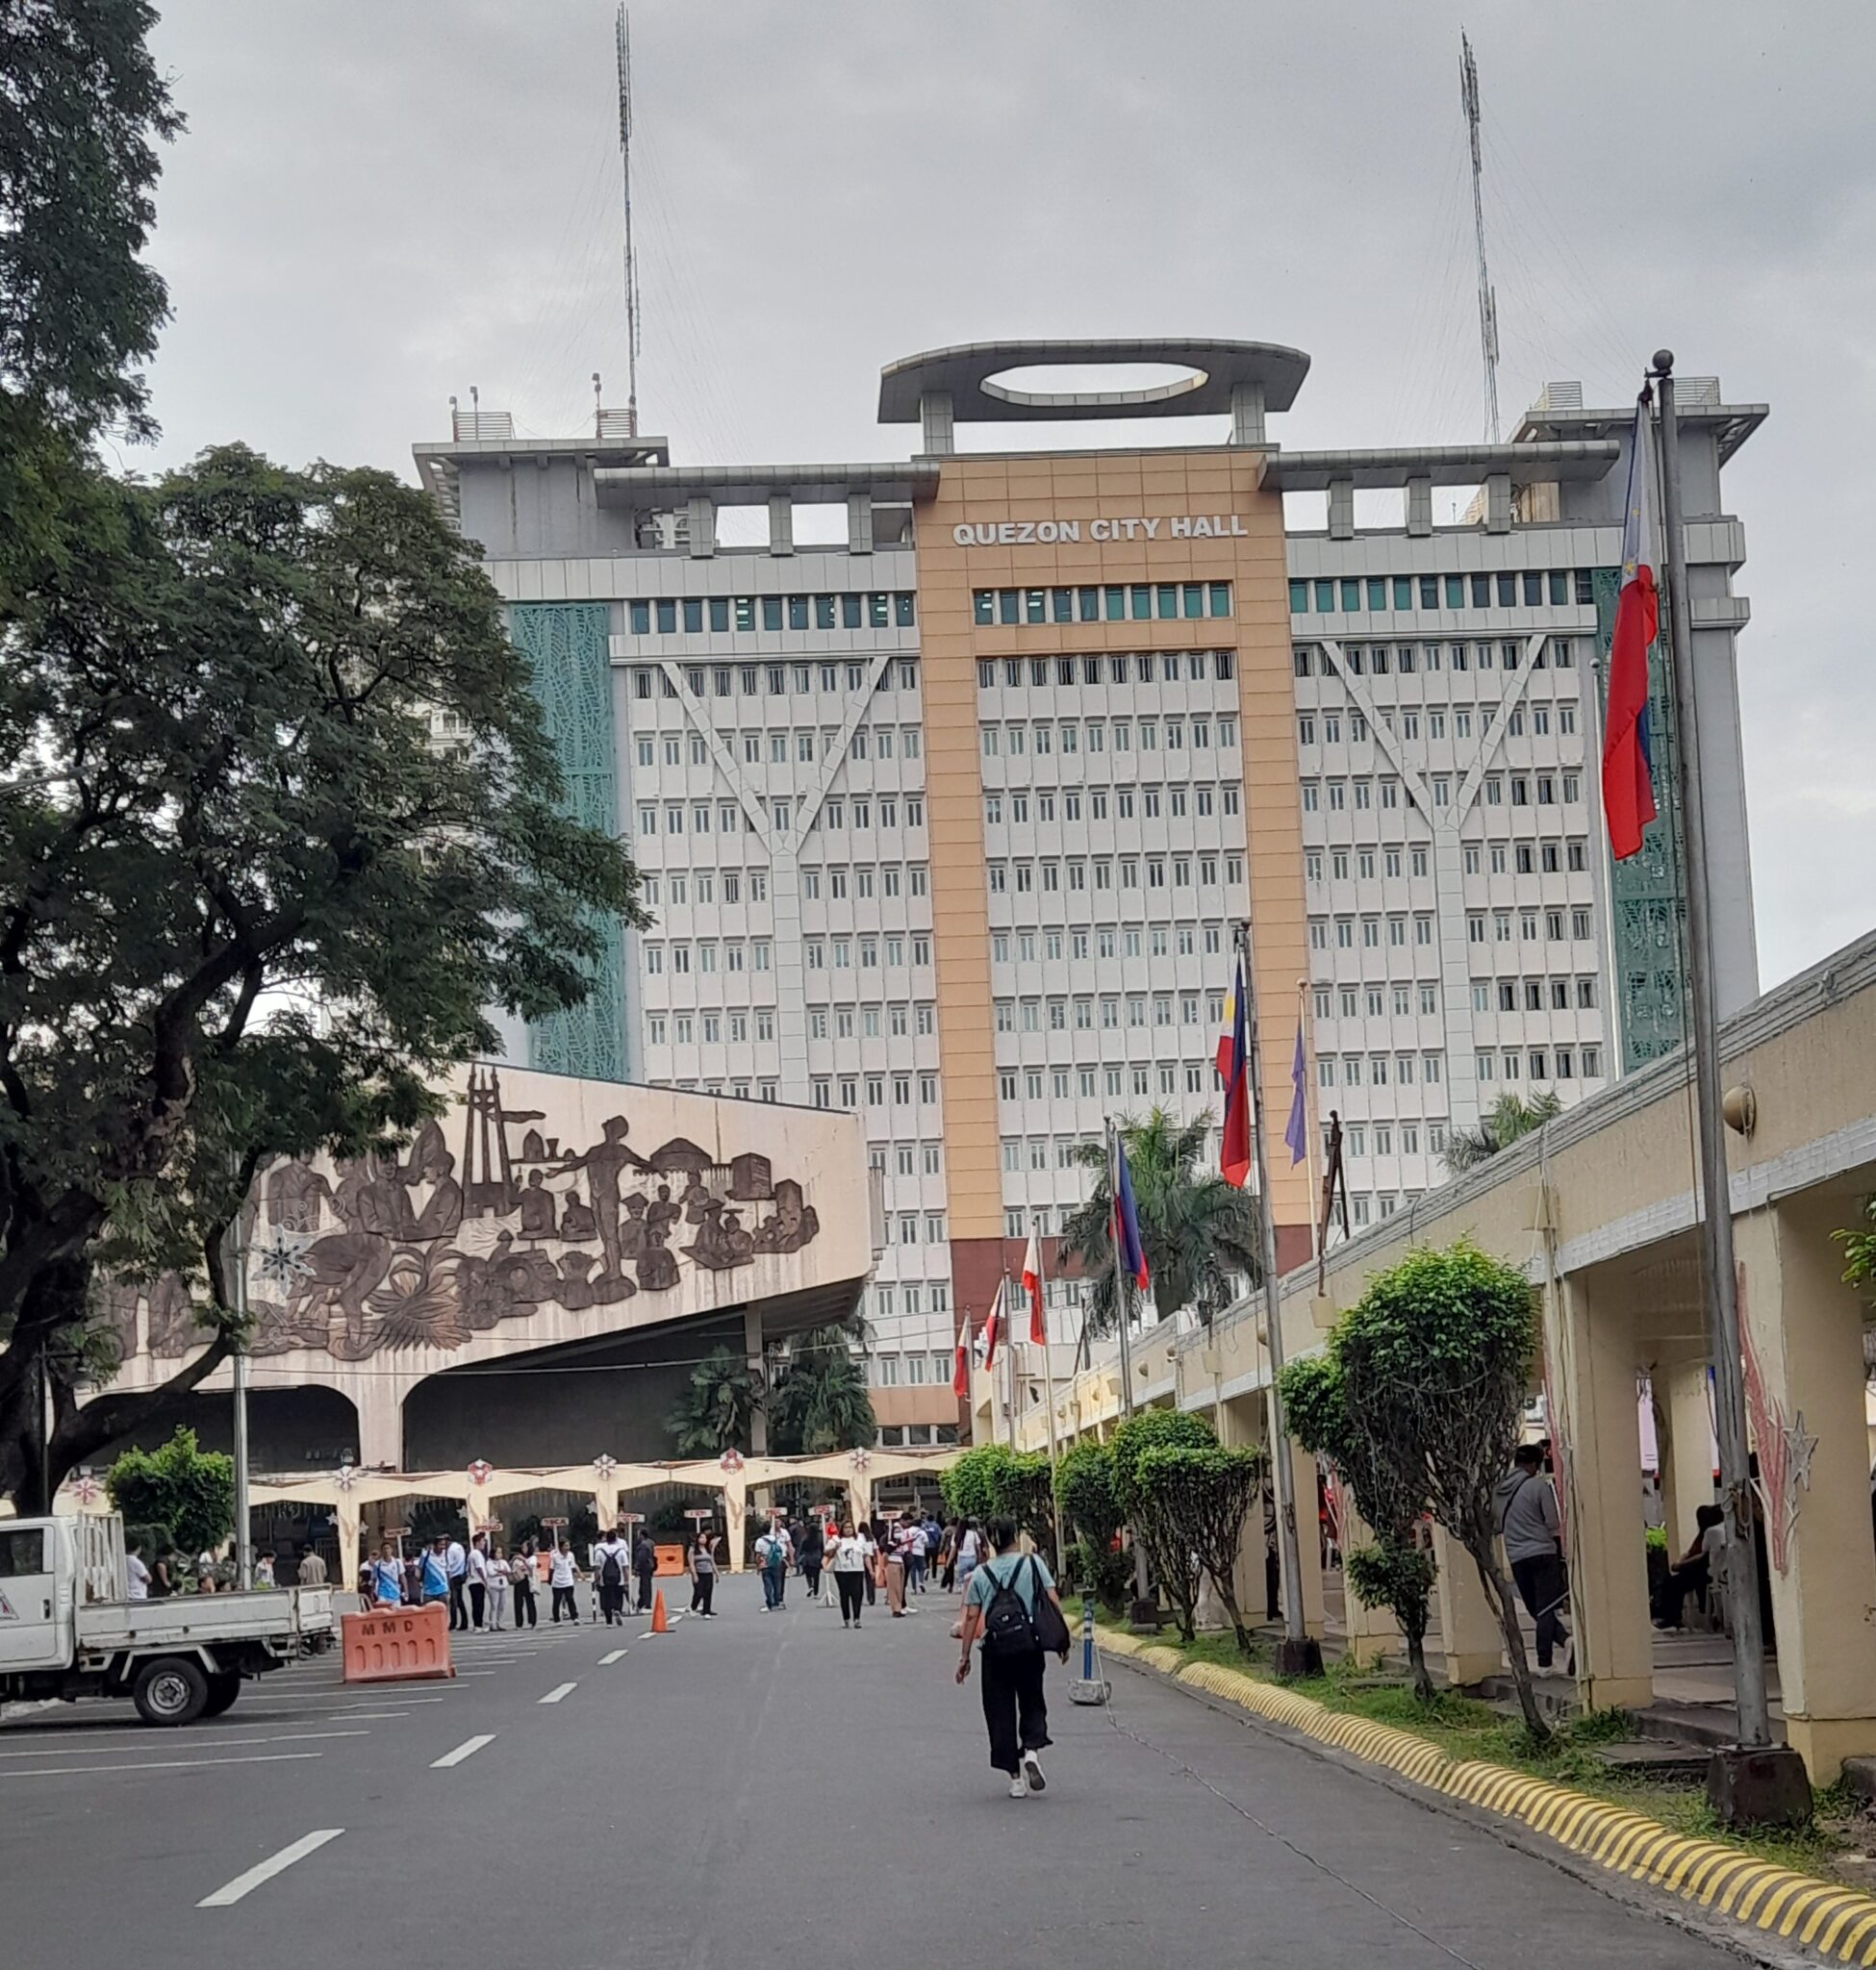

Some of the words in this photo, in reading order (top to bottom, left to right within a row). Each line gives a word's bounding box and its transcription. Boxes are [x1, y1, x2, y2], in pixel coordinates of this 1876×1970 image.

[953, 520, 1079, 545] QUEZON
[1090, 518, 1160, 541] CITY
[1171, 515, 1249, 538] HALL
[362, 1618, 431, 1636] MMD
